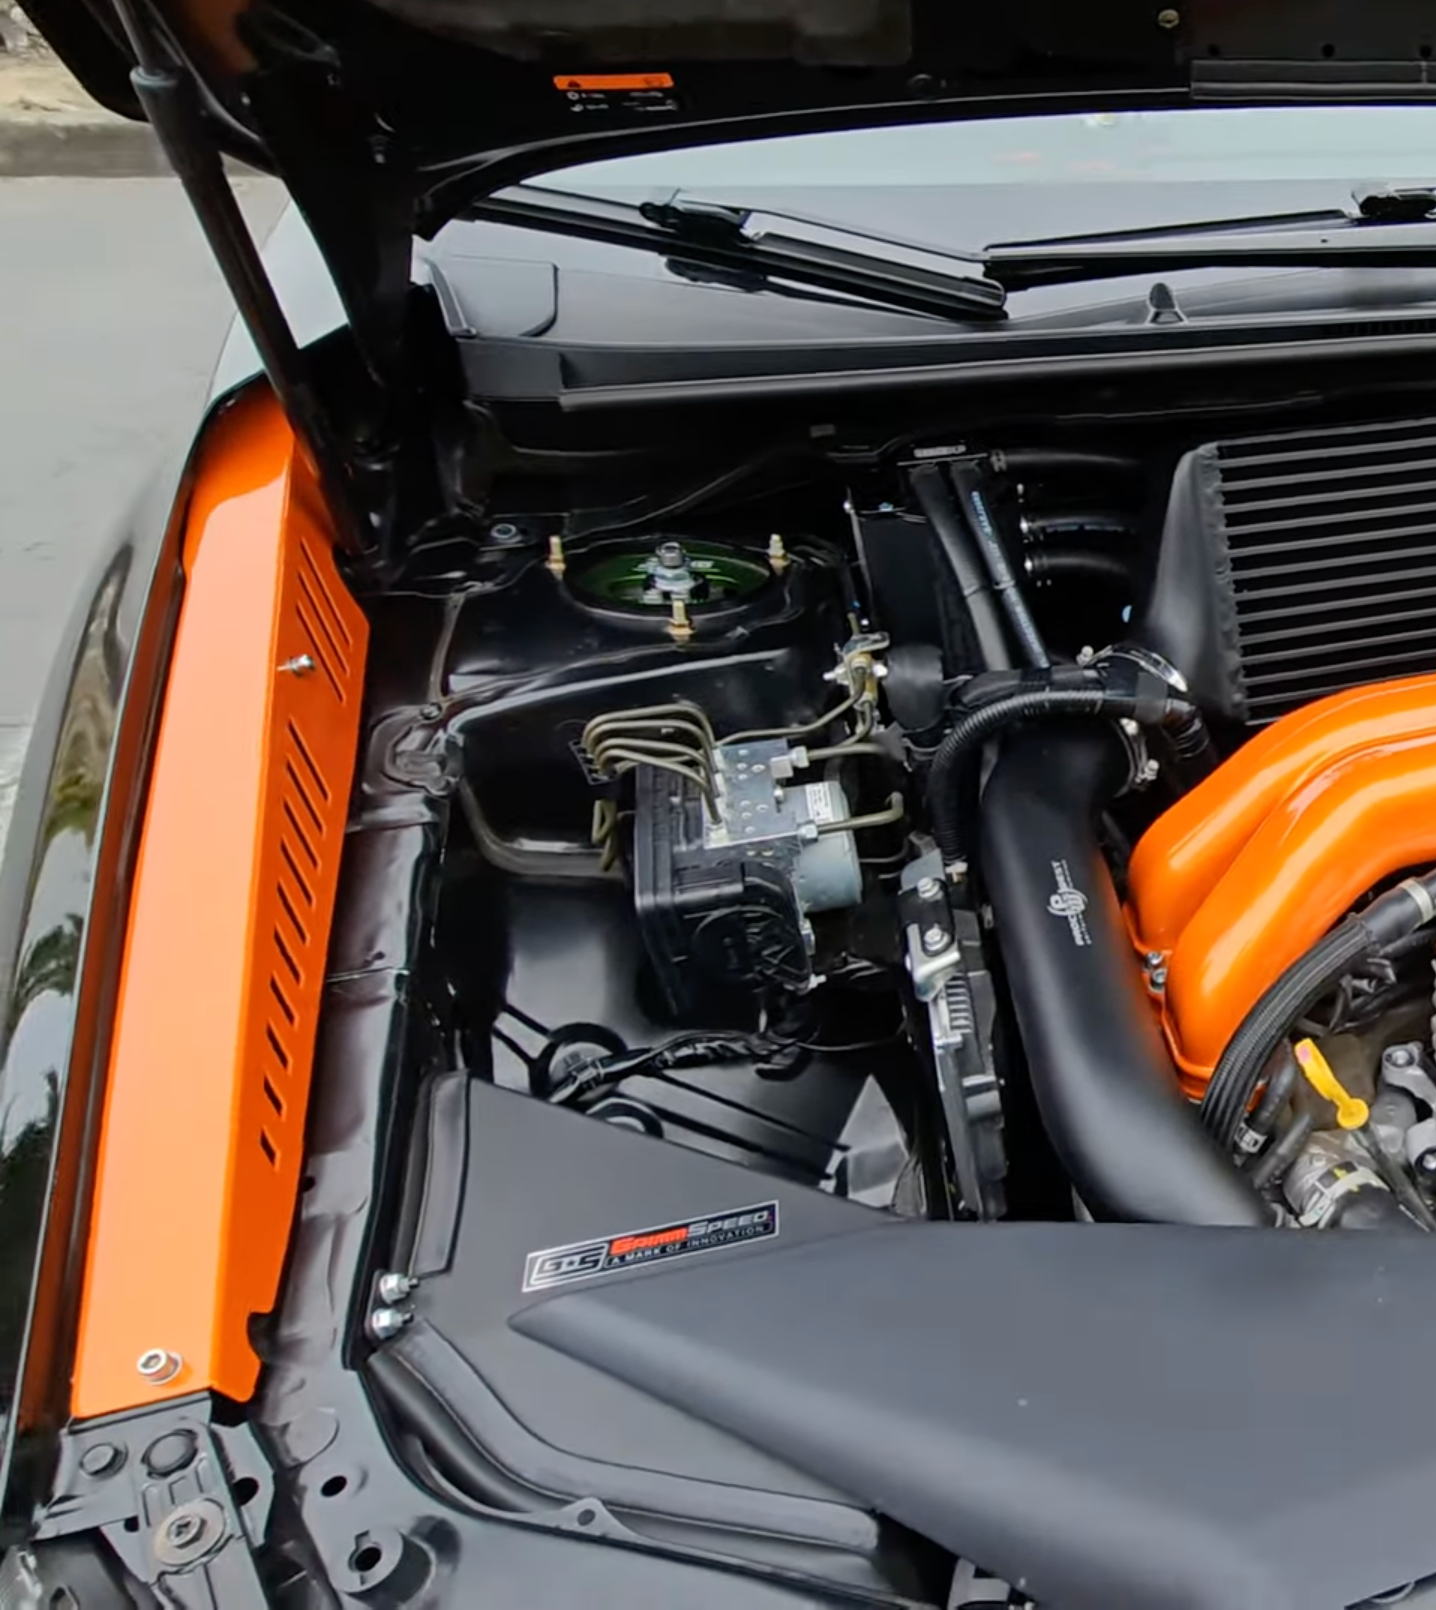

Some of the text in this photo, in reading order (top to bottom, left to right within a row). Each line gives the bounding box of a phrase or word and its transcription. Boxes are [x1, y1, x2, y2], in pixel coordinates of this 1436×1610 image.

[612, 1225, 764, 1265] A MARK OF INNOVATION
